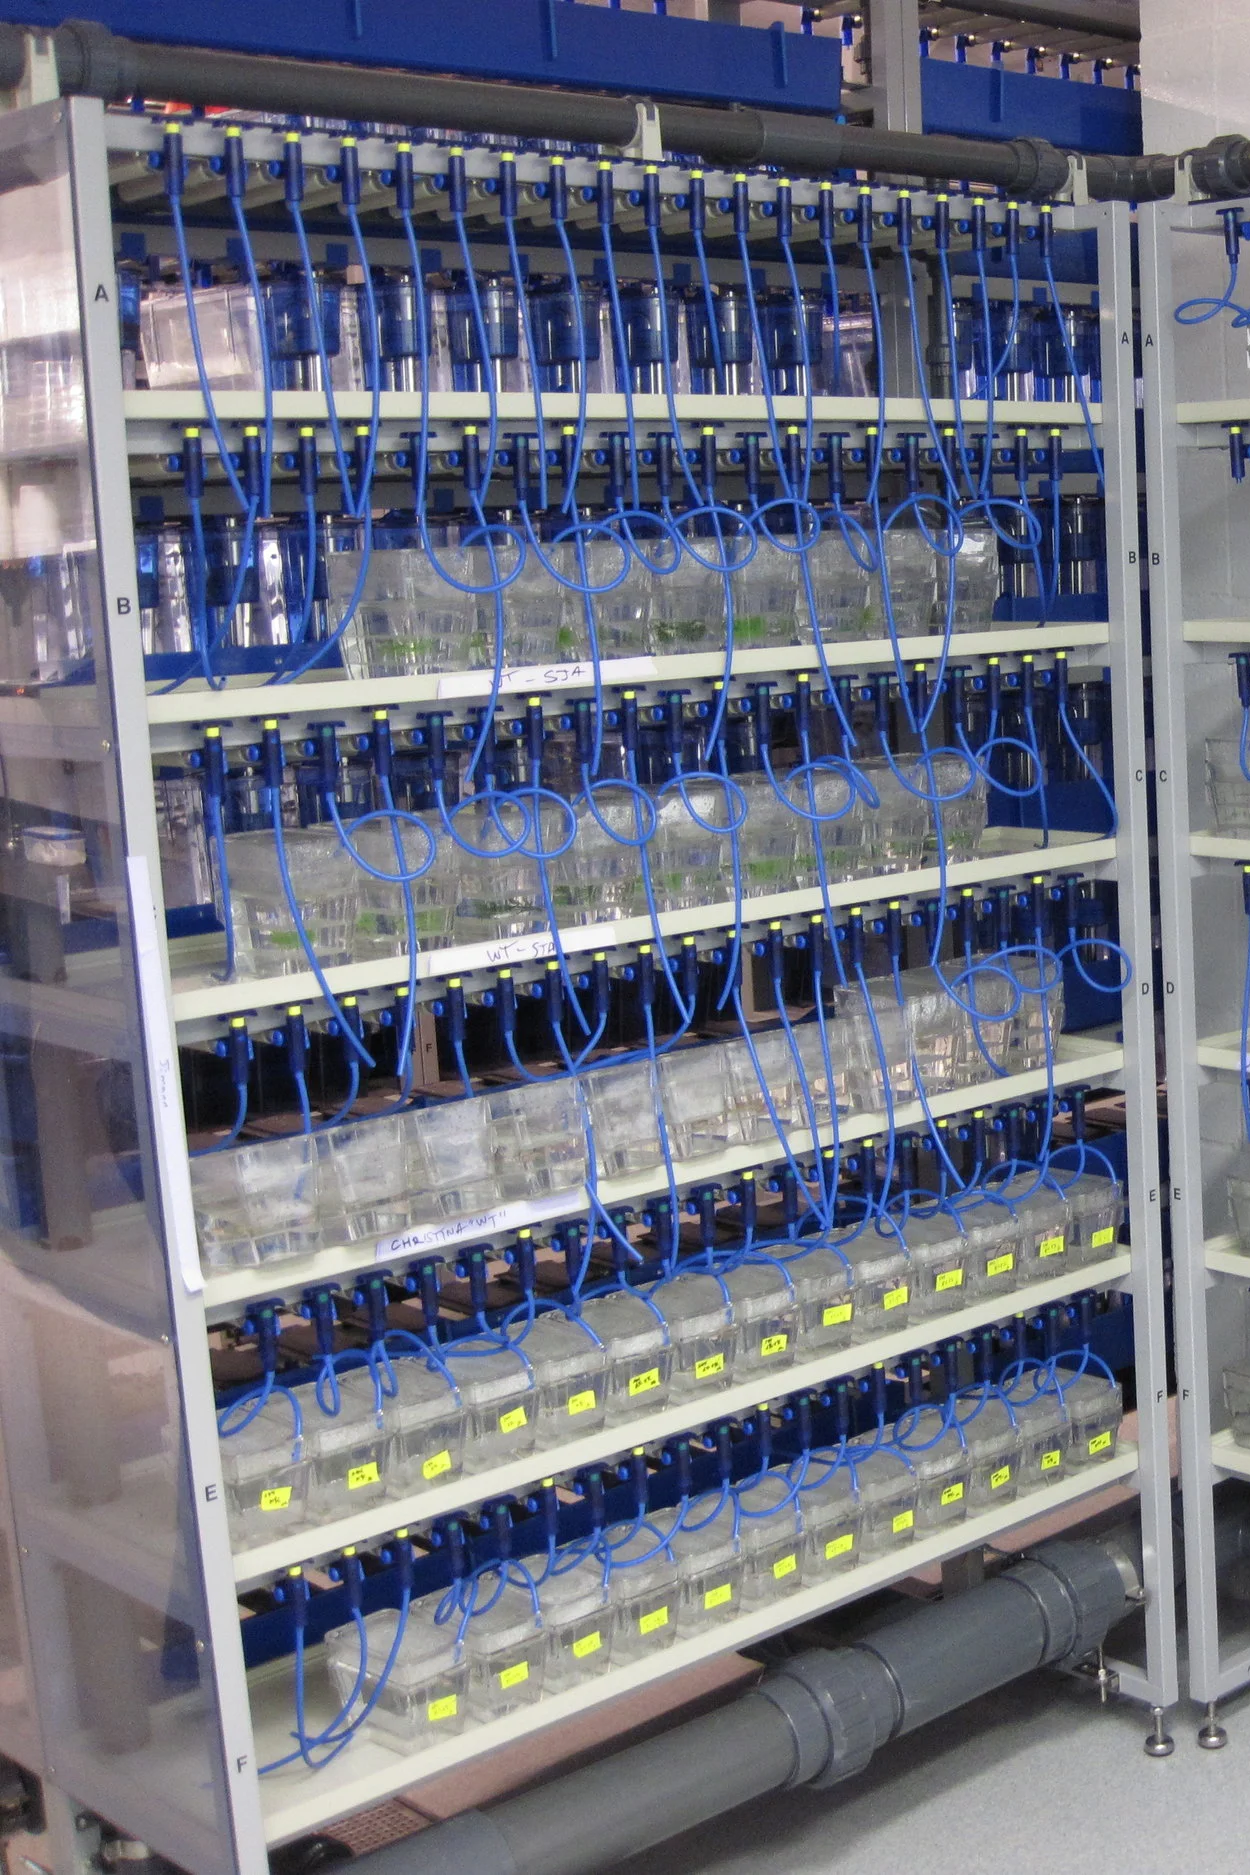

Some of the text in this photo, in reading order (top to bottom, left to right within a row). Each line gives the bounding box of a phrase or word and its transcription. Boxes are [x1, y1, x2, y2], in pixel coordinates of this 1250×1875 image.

[94, 284, 110, 303] A
[1121, 332, 1130, 345] A
[1145, 334, 1154, 348] A
[1128, 551, 1137, 565] B
[1151, 553, 1161, 566] B
[117, 597, 132, 616] B
[1135, 770, 1143, 782] C
[1159, 770, 1168, 783] C
[487, 941, 518, 962] WT
[1141, 983, 1150, 996] D
[1165, 982, 1175, 995] D
[426, 1043, 433, 1054] F
[1149, 1189, 1157, 1202] E
[1173, 1188, 1182, 1201] E
[390, 1222, 468, 1251] CHRISTINA
[1156, 1390, 1164, 1404] F
[1182, 1389, 1190, 1401] F
[204, 1483, 218, 1503] E
[236, 1756, 248, 1774] F
